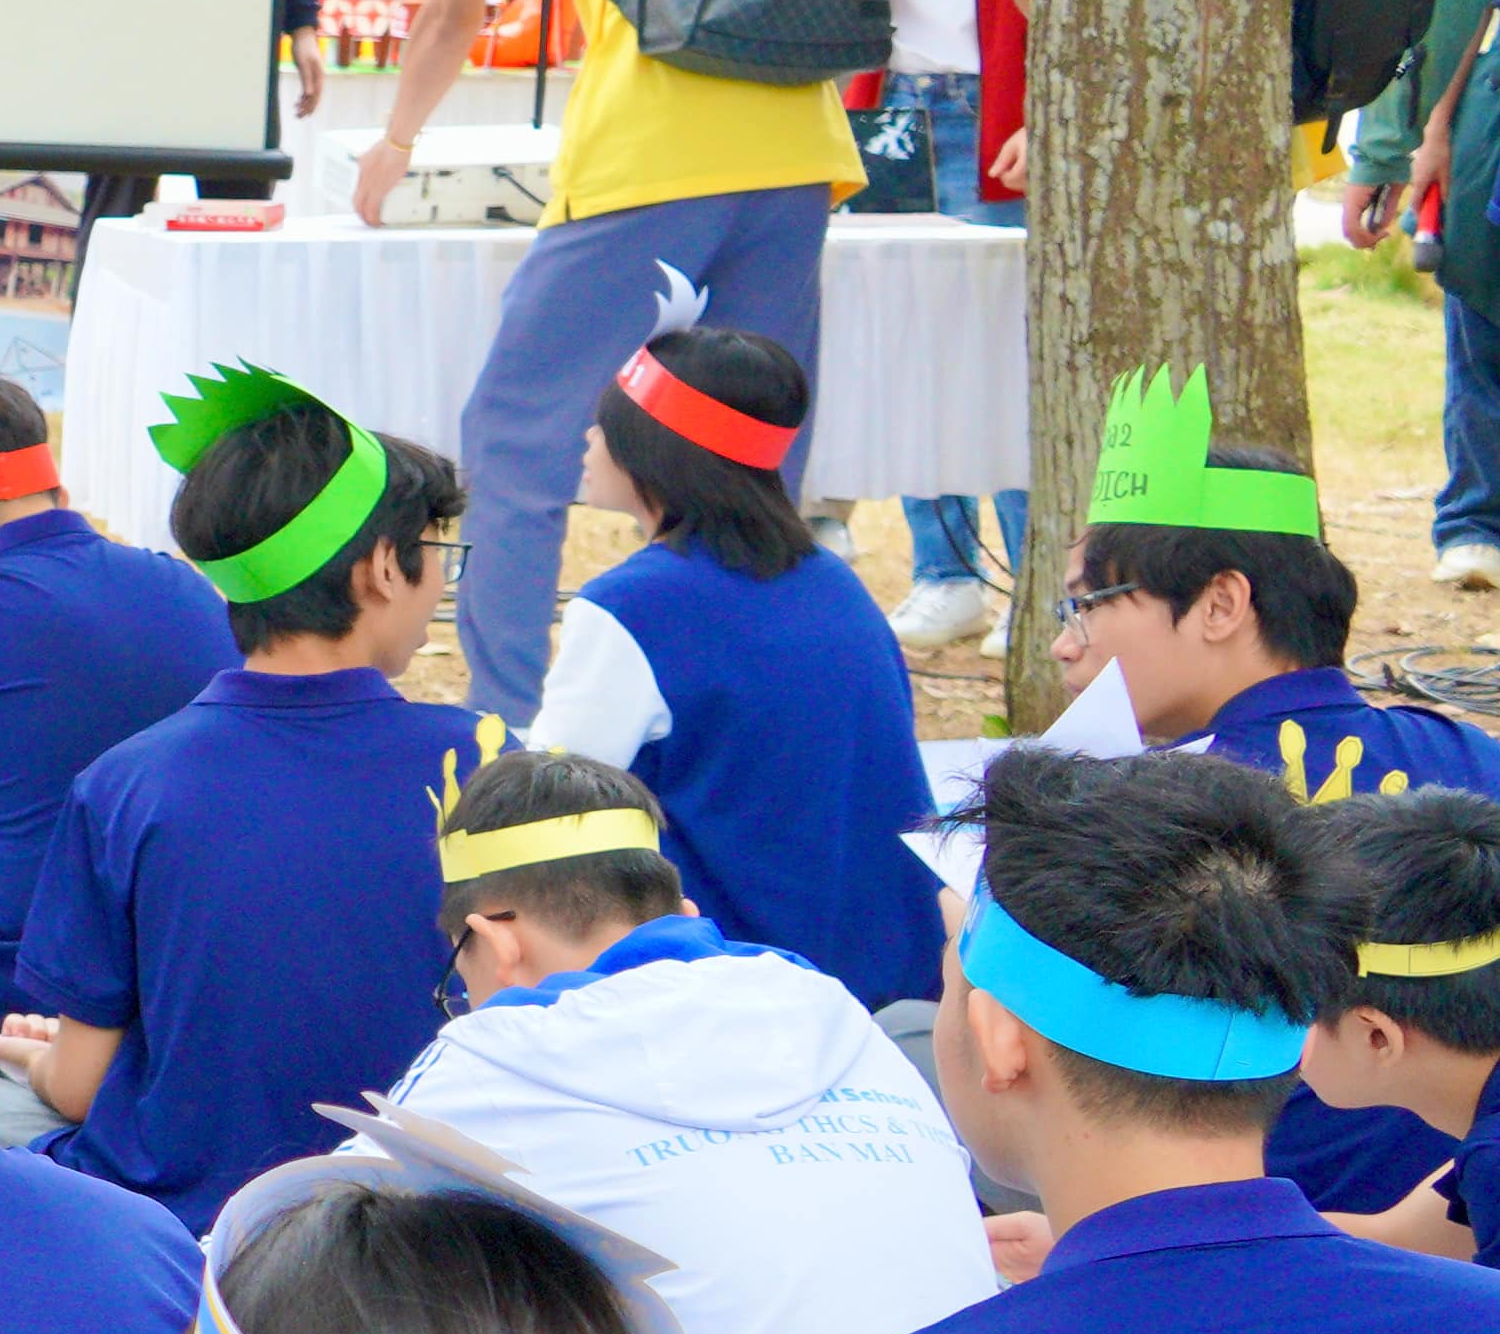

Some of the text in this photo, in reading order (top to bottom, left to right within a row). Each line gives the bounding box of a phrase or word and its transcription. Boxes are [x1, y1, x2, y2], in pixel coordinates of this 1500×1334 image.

[796, 1114, 880, 1134] THCS
[886, 1116, 909, 1136] &
[767, 1142, 915, 1165] BAN MAI
